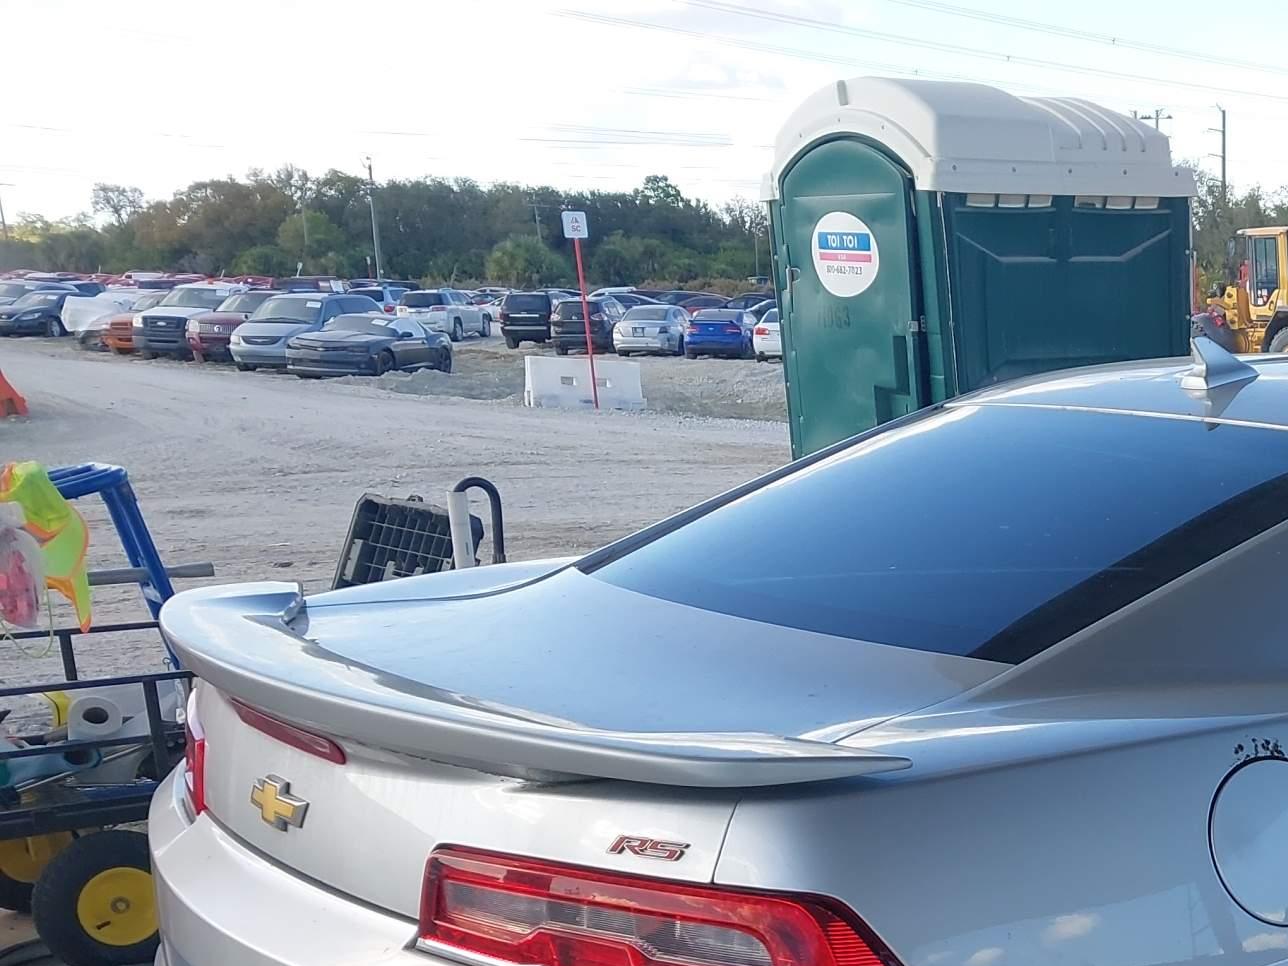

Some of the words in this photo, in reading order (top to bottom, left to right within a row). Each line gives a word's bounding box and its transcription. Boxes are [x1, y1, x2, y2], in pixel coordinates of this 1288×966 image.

[826, 234, 840, 248] TOI
[842, 235, 858, 249] TOI
[606, 835, 691, 862] RS
